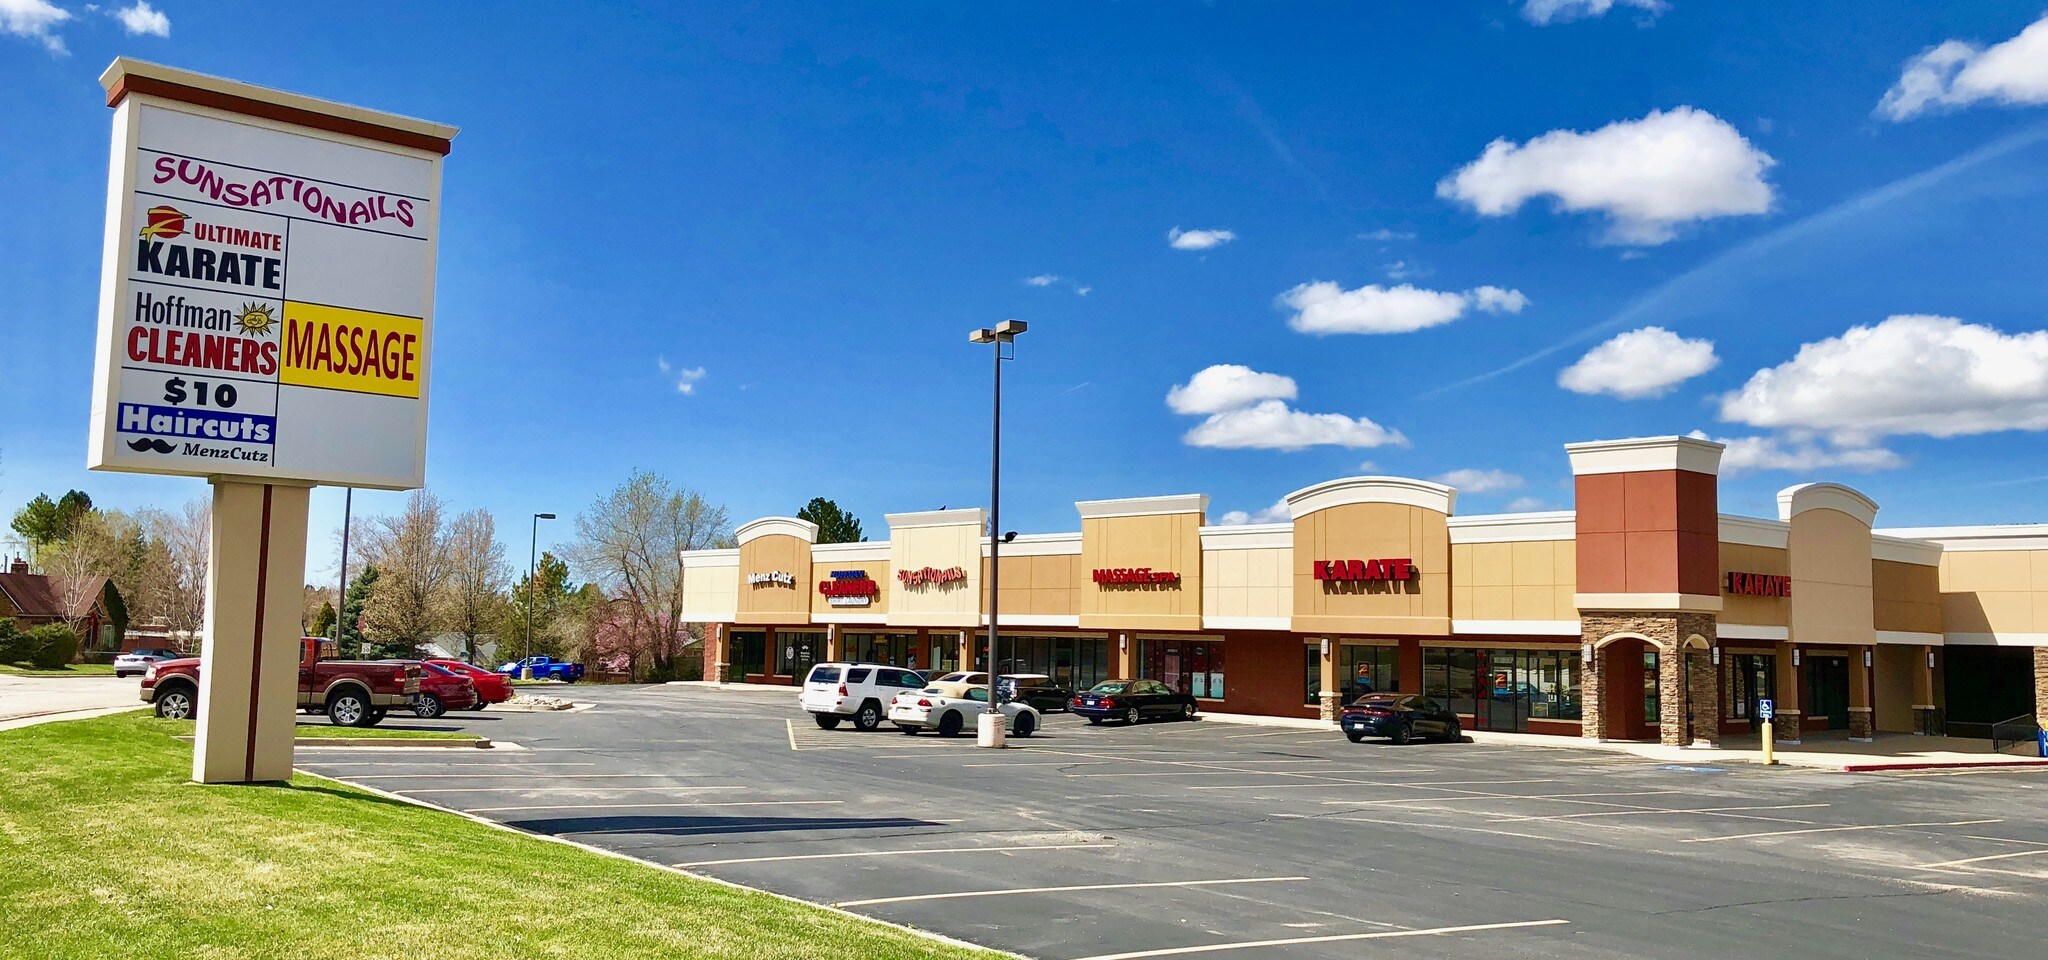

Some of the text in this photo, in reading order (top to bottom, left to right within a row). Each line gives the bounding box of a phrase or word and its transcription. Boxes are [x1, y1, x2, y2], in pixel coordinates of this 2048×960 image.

[153, 156, 414, 228] SUNSATIONAILS
[194, 222, 282, 252] ULTIMATE
[137, 239, 281, 290] KARATE
[135, 291, 232, 332] Hoffman
[127, 325, 277, 376] CLEANERS
[286, 318, 417, 381] MASSAGE
[163, 377, 238, 408] $10
[122, 404, 270, 441] Haircuts
[182, 442, 269, 463] MenzCutz
[748, 570, 792, 585] Menz Cutz
[1092, 567, 1175, 583] MASSAGE SPA
[1313, 558, 1412, 580] KARATE
[819, 579, 876, 596] CLEANERS
[1732, 573, 1791, 597] KARATE
